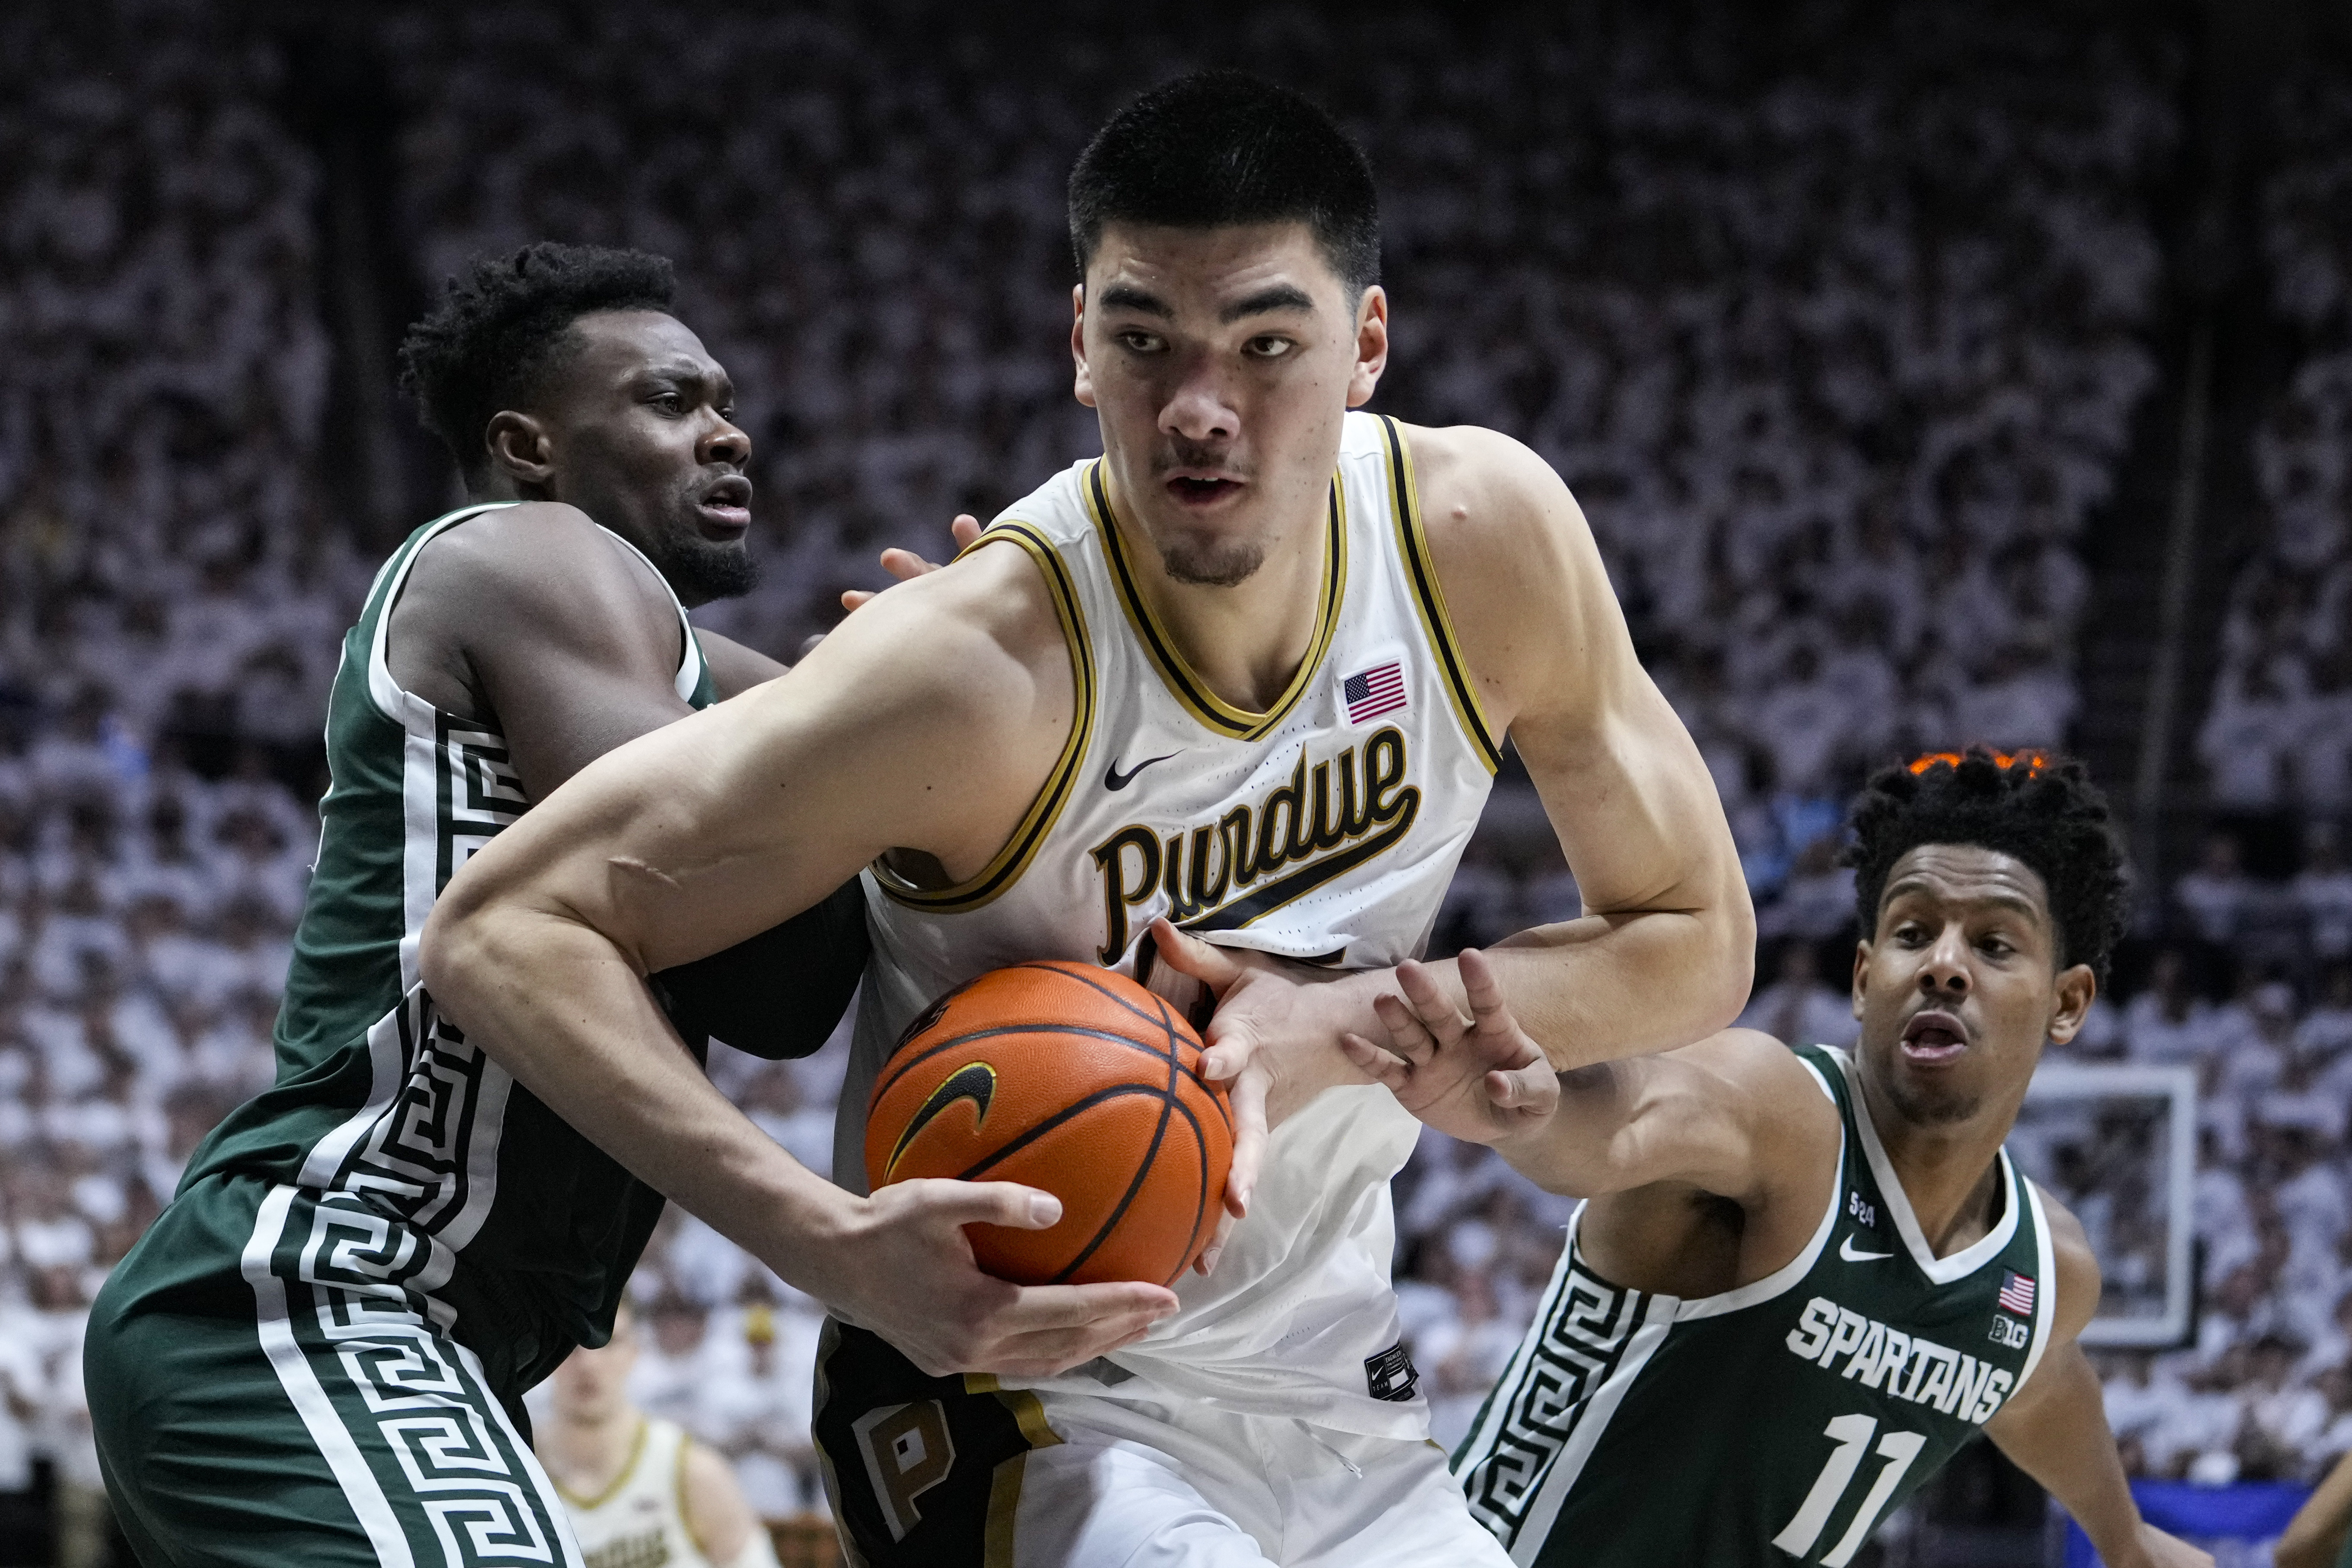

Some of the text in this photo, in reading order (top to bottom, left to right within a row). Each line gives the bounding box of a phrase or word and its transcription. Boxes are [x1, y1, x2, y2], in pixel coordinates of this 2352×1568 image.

[1088, 726, 1421, 967] Purdue
[1373, 1381, 1388, 1392] TEAM
[1786, 1296, 2013, 1425] SPARTANS
[851, 1399, 956, 1544] P
[1772, 1413, 1927, 1568] 11
